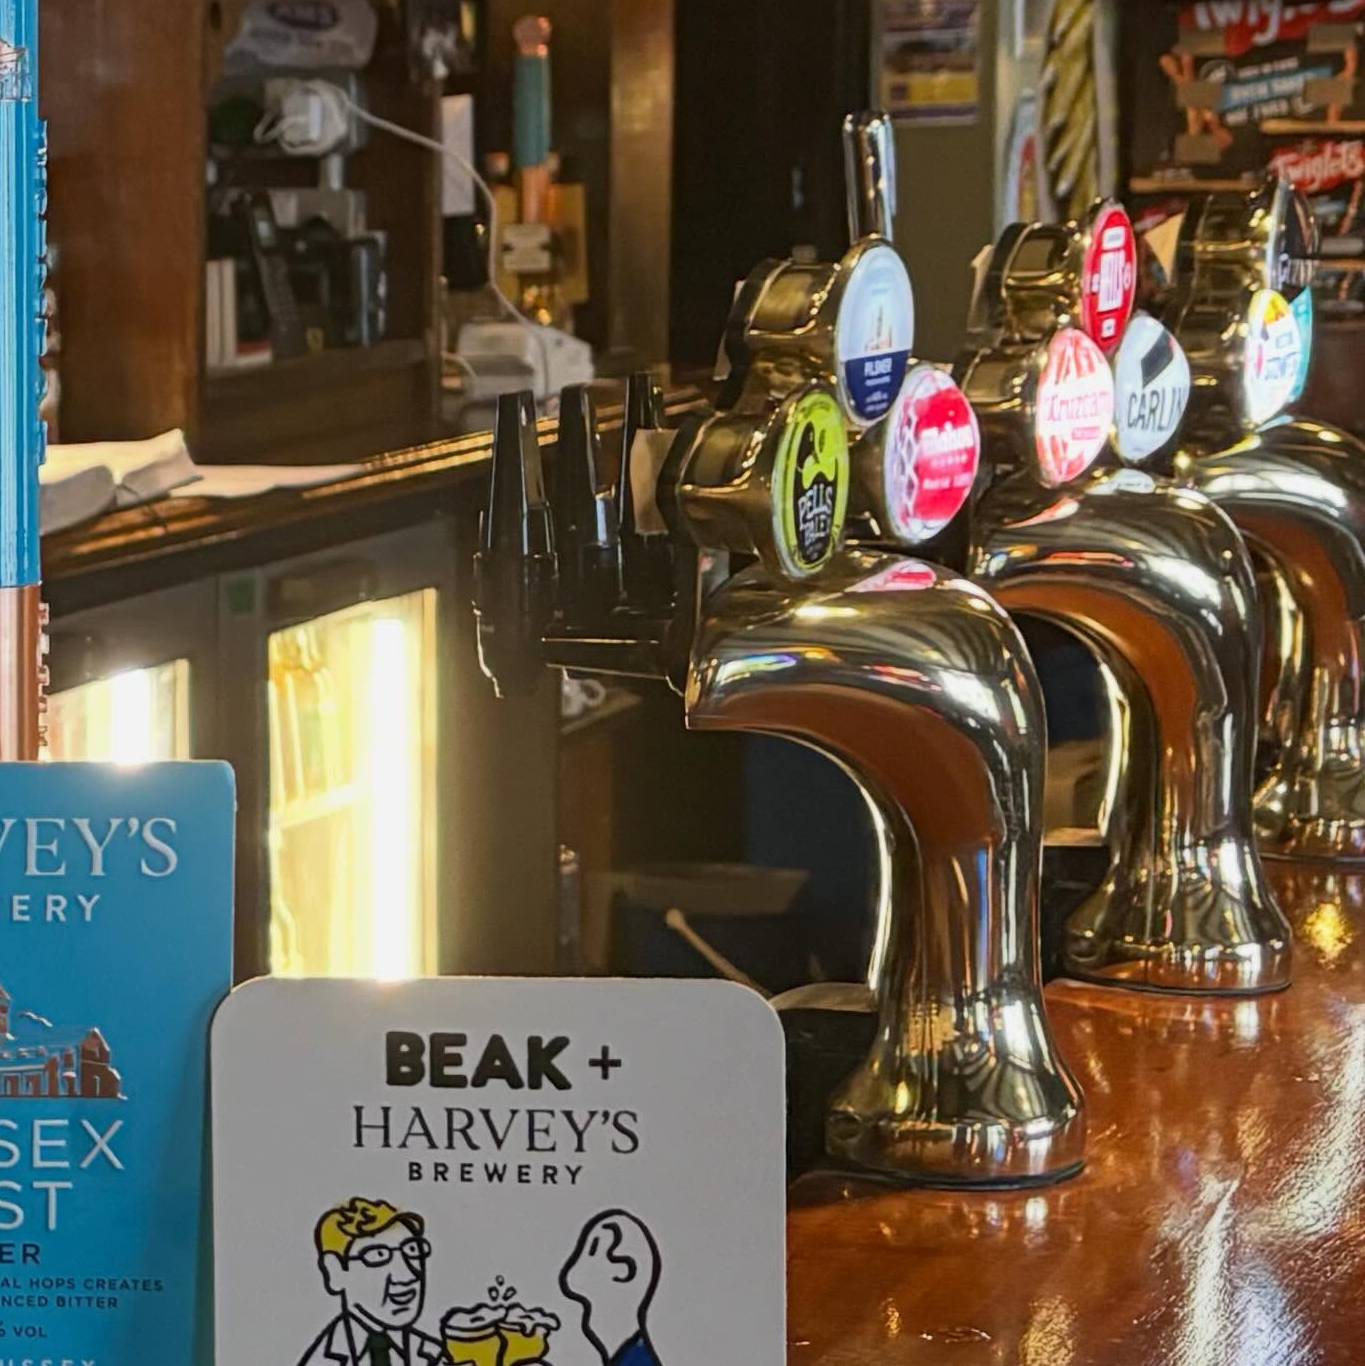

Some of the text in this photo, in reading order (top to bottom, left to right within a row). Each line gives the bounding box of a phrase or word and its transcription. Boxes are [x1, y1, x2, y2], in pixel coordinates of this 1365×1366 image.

[385, 1030, 573, 1091] BEAK
[352, 1104, 641, 1155] HARVEY'S
[408, 1162, 585, 1186] BREWERY
[28, 1276, 76, 1291] HOPS
[82, 1277, 165, 1292] CREATES
[55, 1295, 119, 1310] BITTER
[12, 1324, 47, 1339] VOL
